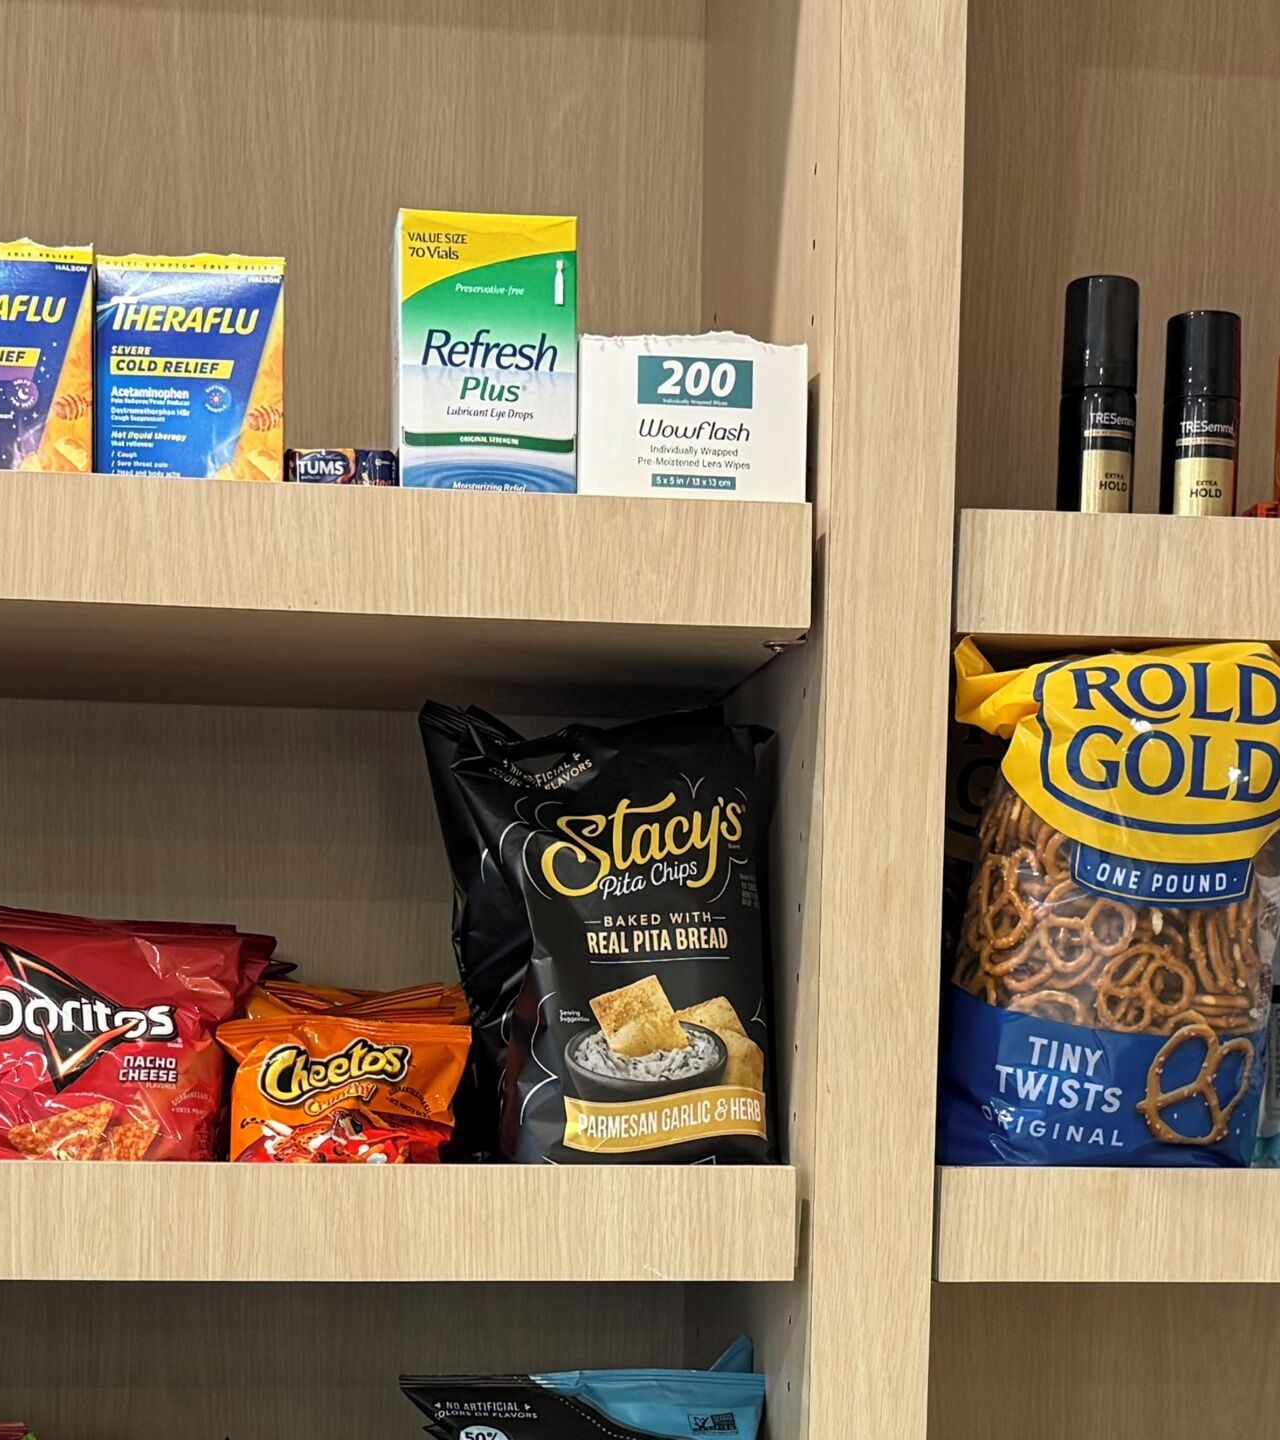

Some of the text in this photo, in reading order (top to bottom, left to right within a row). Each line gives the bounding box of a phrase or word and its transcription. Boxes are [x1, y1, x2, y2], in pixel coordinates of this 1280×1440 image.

[407, 231, 469, 245] VALUE SIZE
[408, 245, 460, 261] 70 Vials
[110, 296, 260, 336] THERAFLU
[110, 345, 152, 356] SEVERE
[421, 328, 559, 373] Refresh
[115, 359, 220, 375] COLD RELIEF
[656, 359, 737, 398] 200
[110, 386, 190, 400] Acetaminophen
[459, 375, 520, 403] Plus
[638, 417, 751, 444] Wowflash
[637, 456, 751, 470] Pre-Moistened Lens Wipes
[650, 444, 739, 459] Individually Wrapped
[298, 457, 346, 477] TUMS
[1098, 480, 1128, 493] HOLD
[1189, 487, 1222, 499] HOLD
[539, 791, 744, 897] Stacy's
[599, 859, 698, 900] Pita Chips
[1095, 867, 1229, 894] ONE POUND
[603, 911, 713, 928] BAKED WITH
[586, 926, 729, 955] REAL PITA BREAD
[122, 1055, 177, 1070] NACHO
[1028, 1035, 1105, 1077] TINY
[118, 1067, 178, 1083] CHEESE
[262, 1040, 410, 1100] Cheetos
[994, 1064, 1123, 1115] TWISTS
[577, 1097, 762, 1141] PARMESAN GARLIC & HERB
